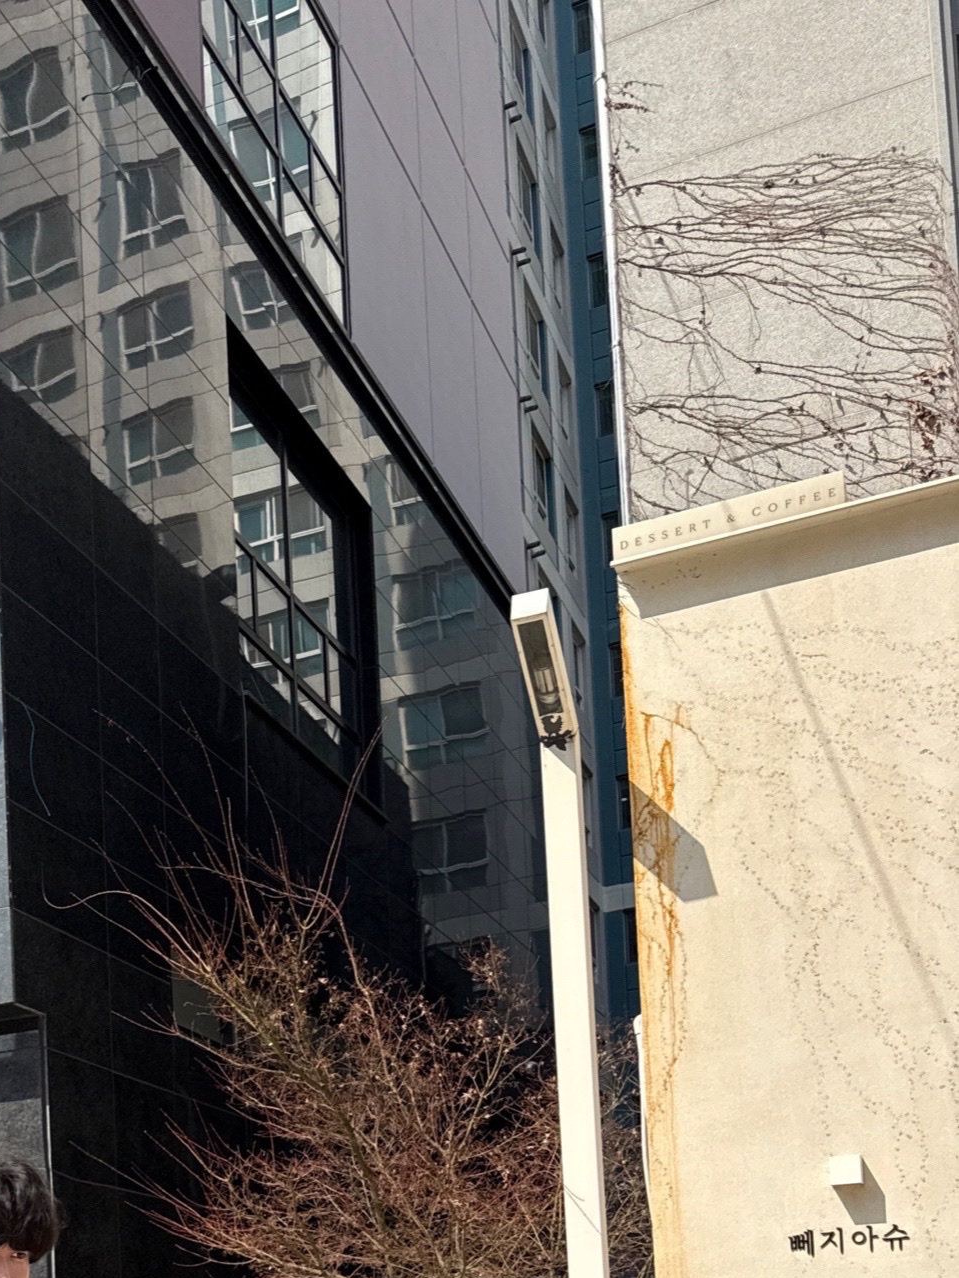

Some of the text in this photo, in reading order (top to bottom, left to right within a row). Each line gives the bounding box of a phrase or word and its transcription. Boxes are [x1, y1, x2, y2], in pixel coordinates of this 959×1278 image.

[619, 487, 837, 551] DESSERT & COFFEE
[788, 1224, 910, 1258] 뻬지아슈
